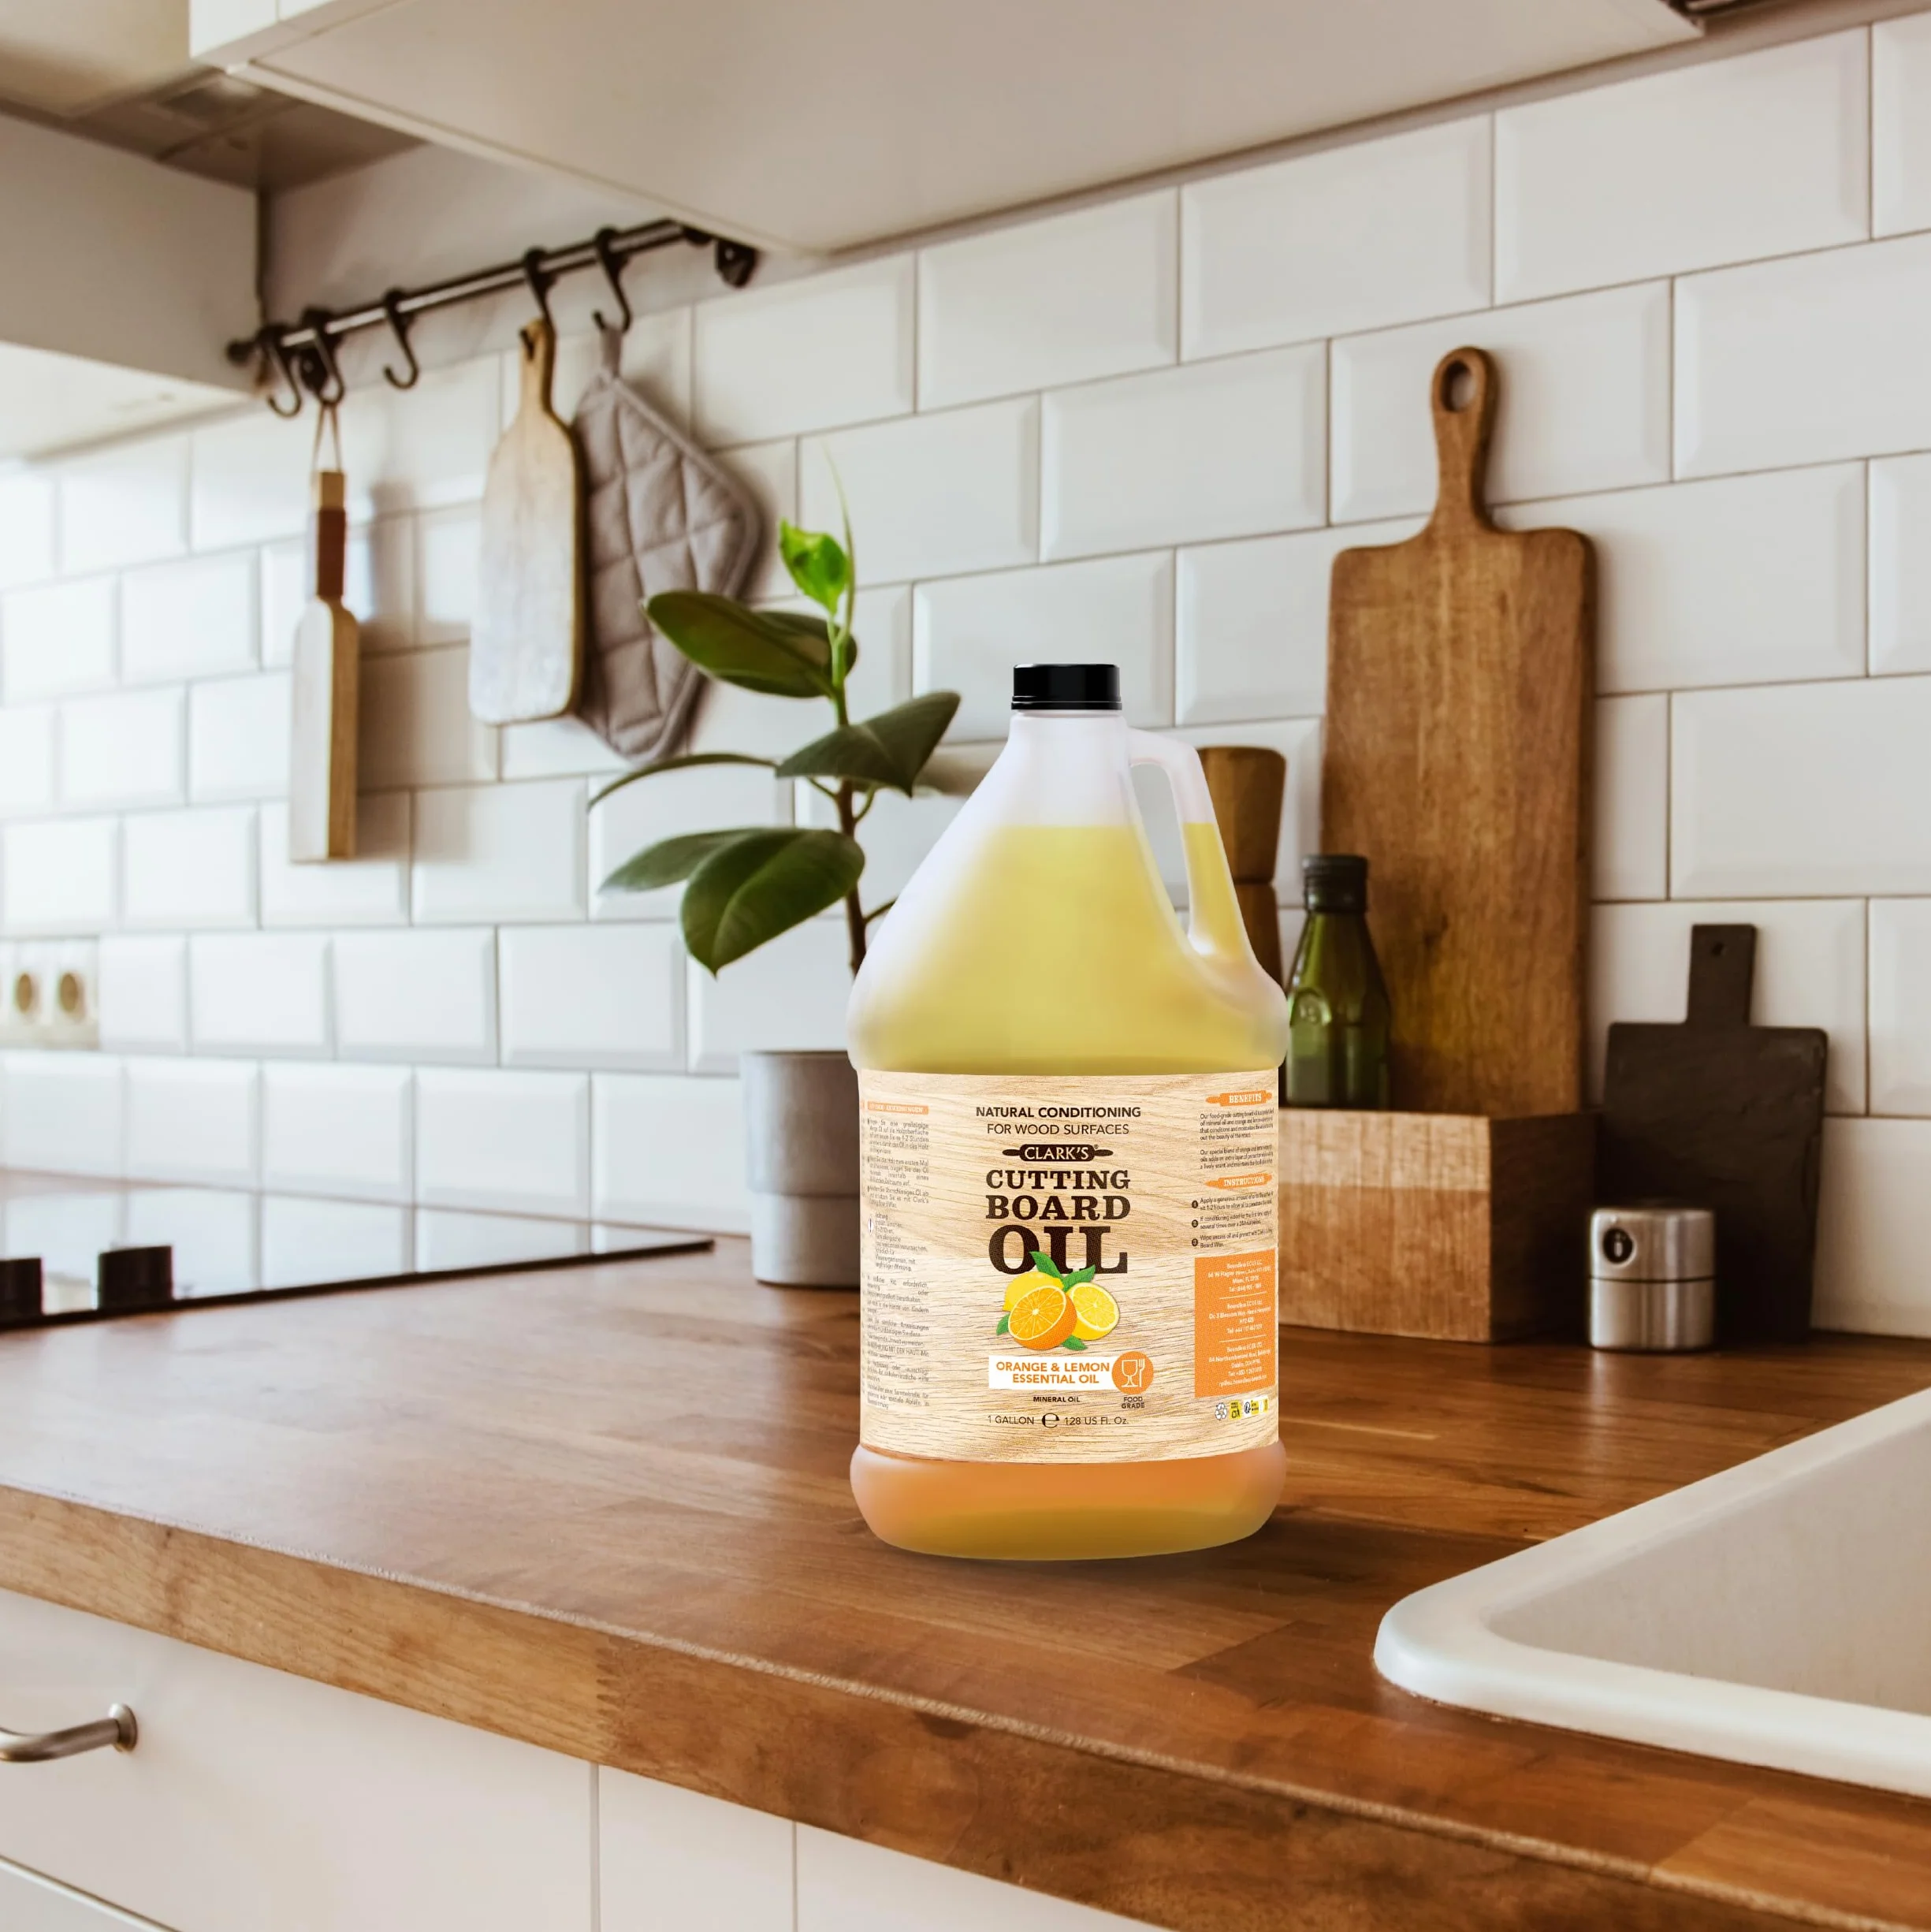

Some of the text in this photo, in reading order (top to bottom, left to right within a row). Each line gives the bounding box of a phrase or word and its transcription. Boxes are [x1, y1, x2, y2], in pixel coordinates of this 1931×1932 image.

[1229, 1093, 1262, 1104] BENEFITS
[976, 1107, 1141, 1118] NATURAL CONDITIONING
[987, 1123, 1129, 1135] FOR WOOD SURFACES
[1024, 1146, 1088, 1160] CLARK'S
[985, 1170, 1131, 1189] CUTTING
[985, 1195, 1131, 1221] BOARD
[988, 1224, 1128, 1275] OIL
[995, 1361, 1110, 1372] ORANGE & LEMON
[1012, 1374, 1099, 1384] ESSENTIAL OIL
[988, 1415, 992, 1424] 1
[995, 1416, 1034, 1425] GALLON
[1064, 1416, 1081, 1425] 128
[1085, 1416, 1097, 1425] US
